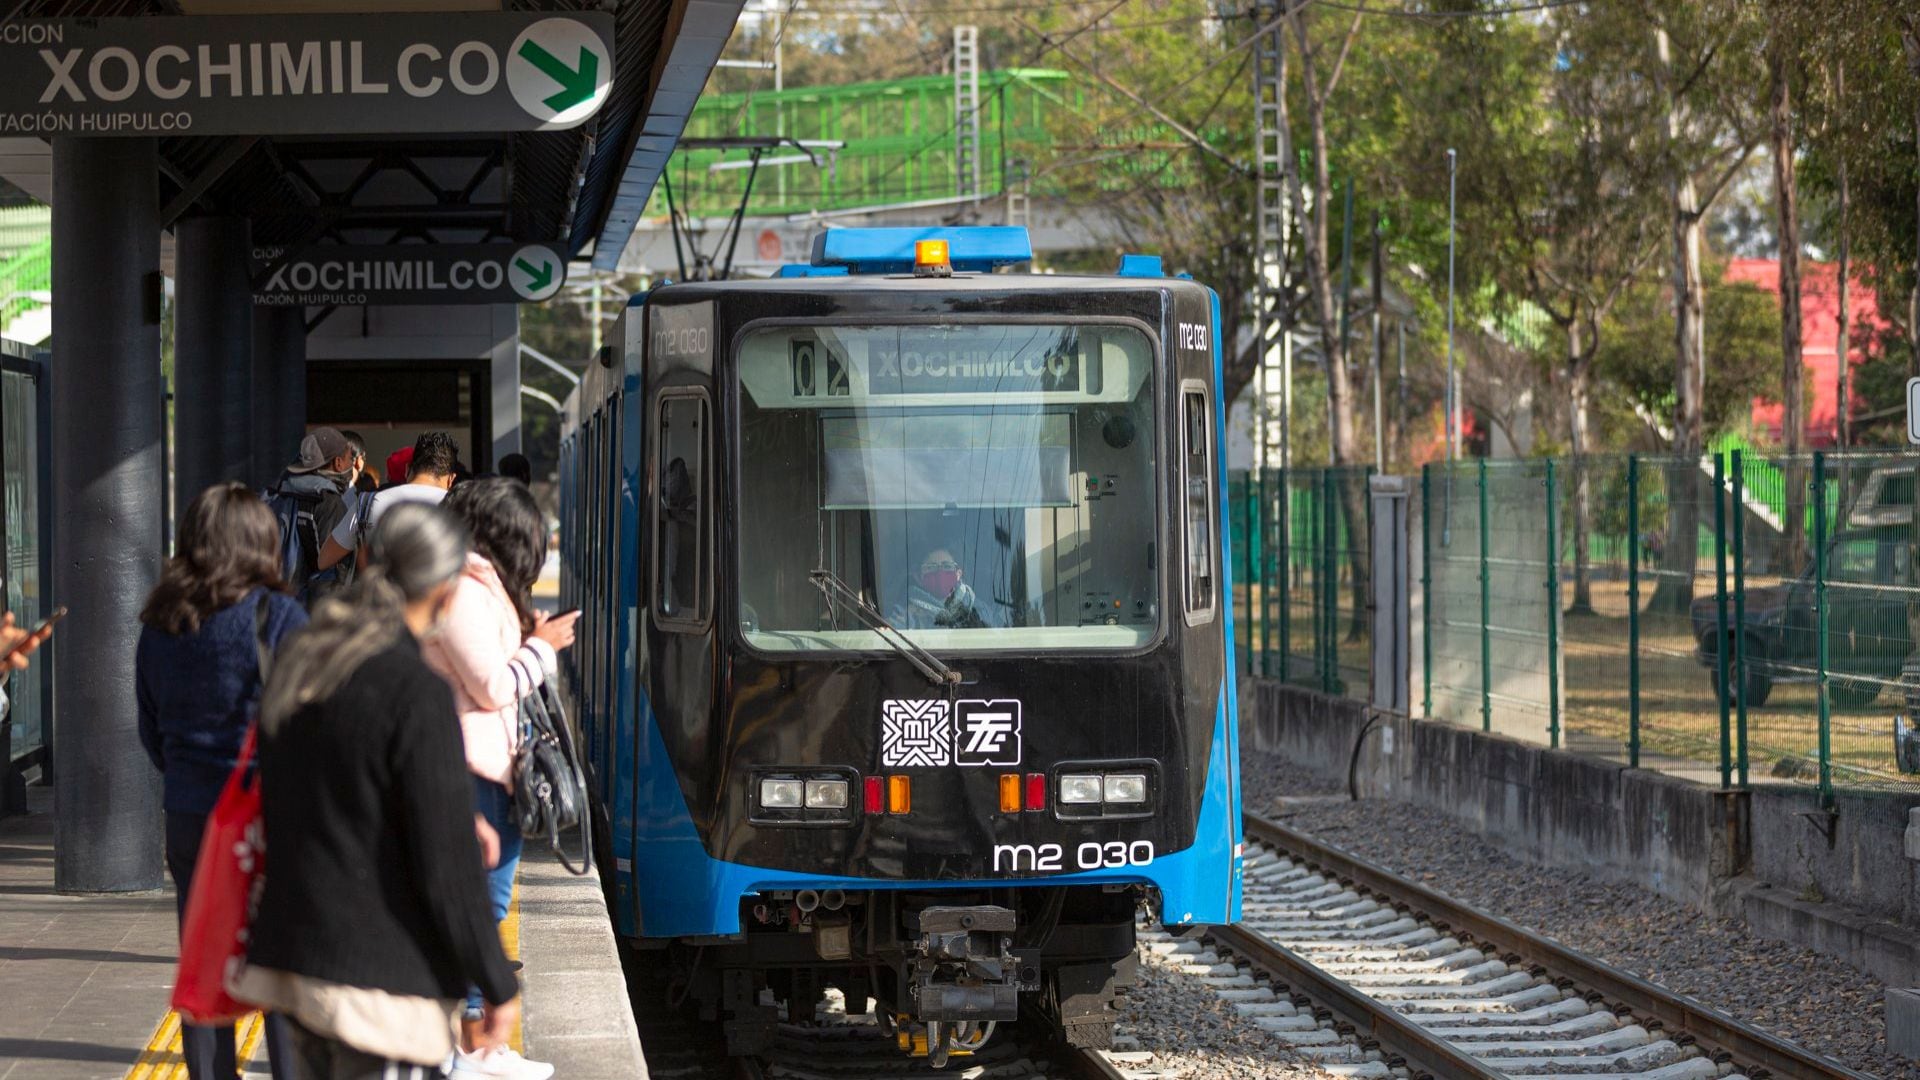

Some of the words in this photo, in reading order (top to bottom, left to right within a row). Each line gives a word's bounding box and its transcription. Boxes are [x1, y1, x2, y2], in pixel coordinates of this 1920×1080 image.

[0, 24, 63, 43] CION
[38, 41, 499, 103] XOCHIMILCO
[81, 111, 192, 131] HUIPULCO
[264, 260, 504, 292] XOCHIMILCO
[300, 294, 367, 305] HUIPULCO
[680, 327, 708, 354] 030
[1194, 324, 1207, 351] 030
[876, 350, 1070, 377] XOCHIMILCO
[1077, 840, 1154, 869] 030
